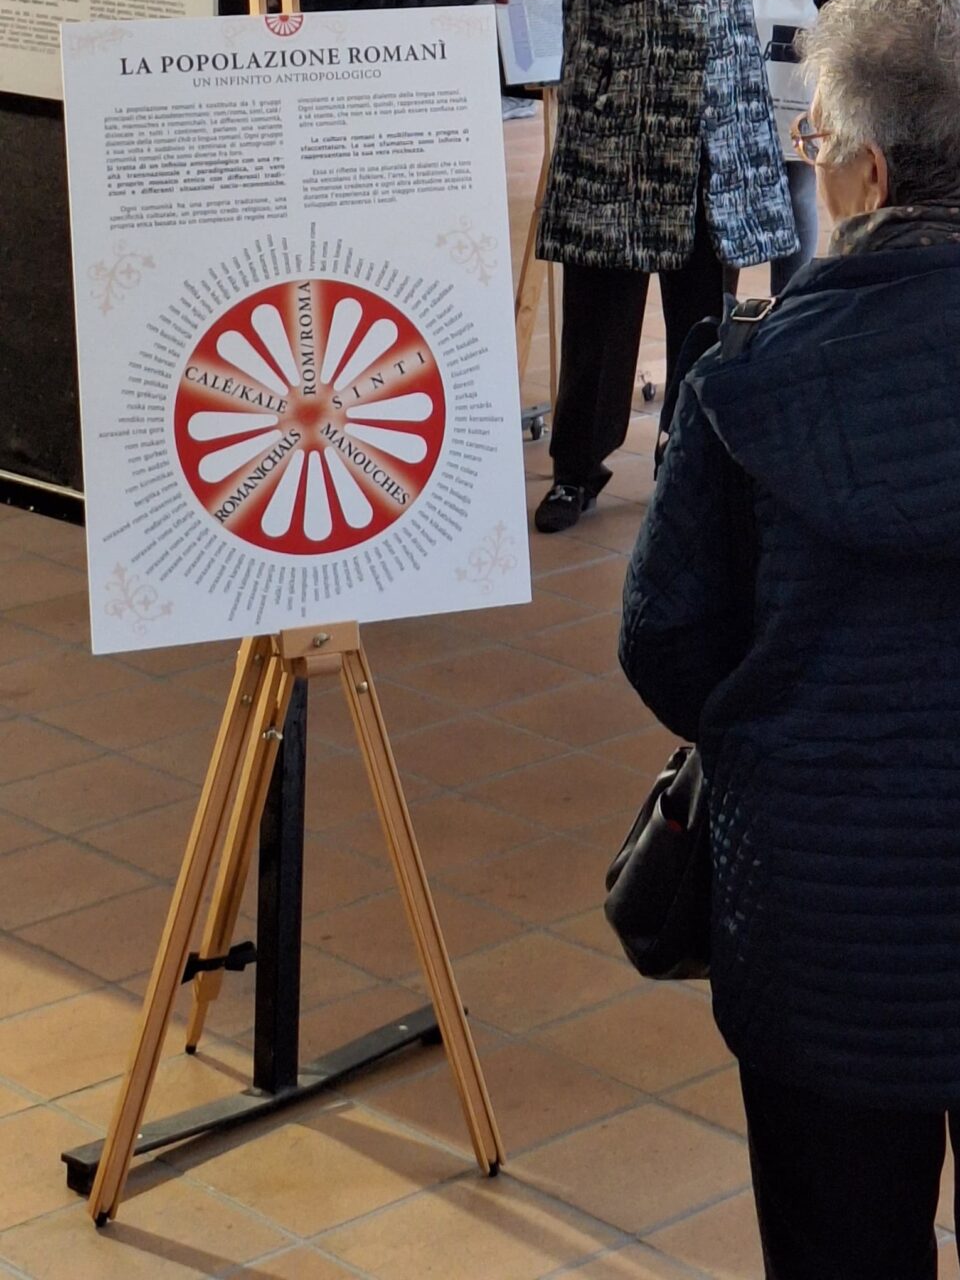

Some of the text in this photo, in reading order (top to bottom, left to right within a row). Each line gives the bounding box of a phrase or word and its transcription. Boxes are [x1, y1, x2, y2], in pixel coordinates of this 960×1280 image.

[120, 40, 447, 76] LA POPOLAZIONE ROMANÌ
[193, 69, 381, 88] UN INFINITO ANTROPOLOGICO
[298, 281, 316, 396] ROM/ROMA
[185, 366, 289, 414] CALÉ/KALE
[332, 351, 427, 409] SINTI
[215, 428, 302, 523] ROMANICHALS
[320, 424, 410, 506] MANOUCHES
